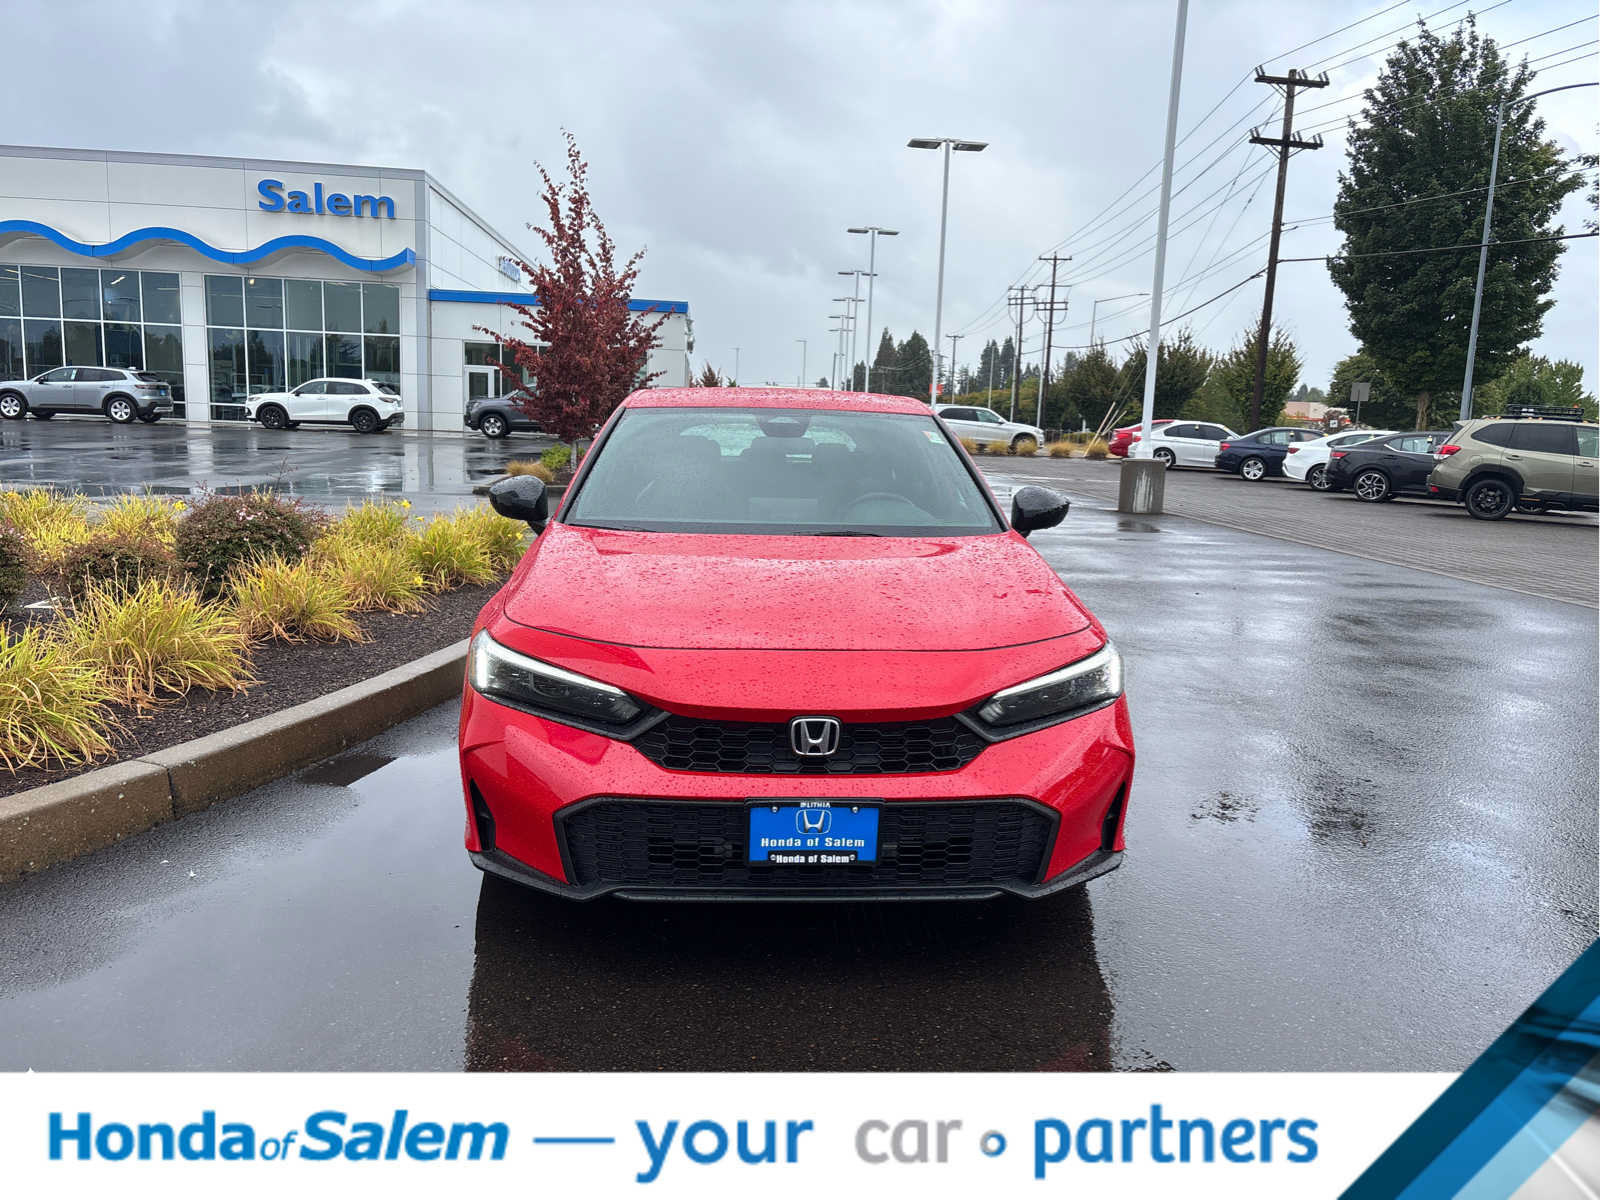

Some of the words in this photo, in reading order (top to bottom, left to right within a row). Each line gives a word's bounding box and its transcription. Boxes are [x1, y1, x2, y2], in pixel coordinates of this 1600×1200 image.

[257, 179, 395, 219] Salem
[761, 837, 801, 847] Honda
[807, 837, 819, 847] of
[825, 837, 865, 847] Salem
[776, 854, 805, 863] Honda
[808, 854, 818, 863] of
[820, 854, 850, 863] Salem
